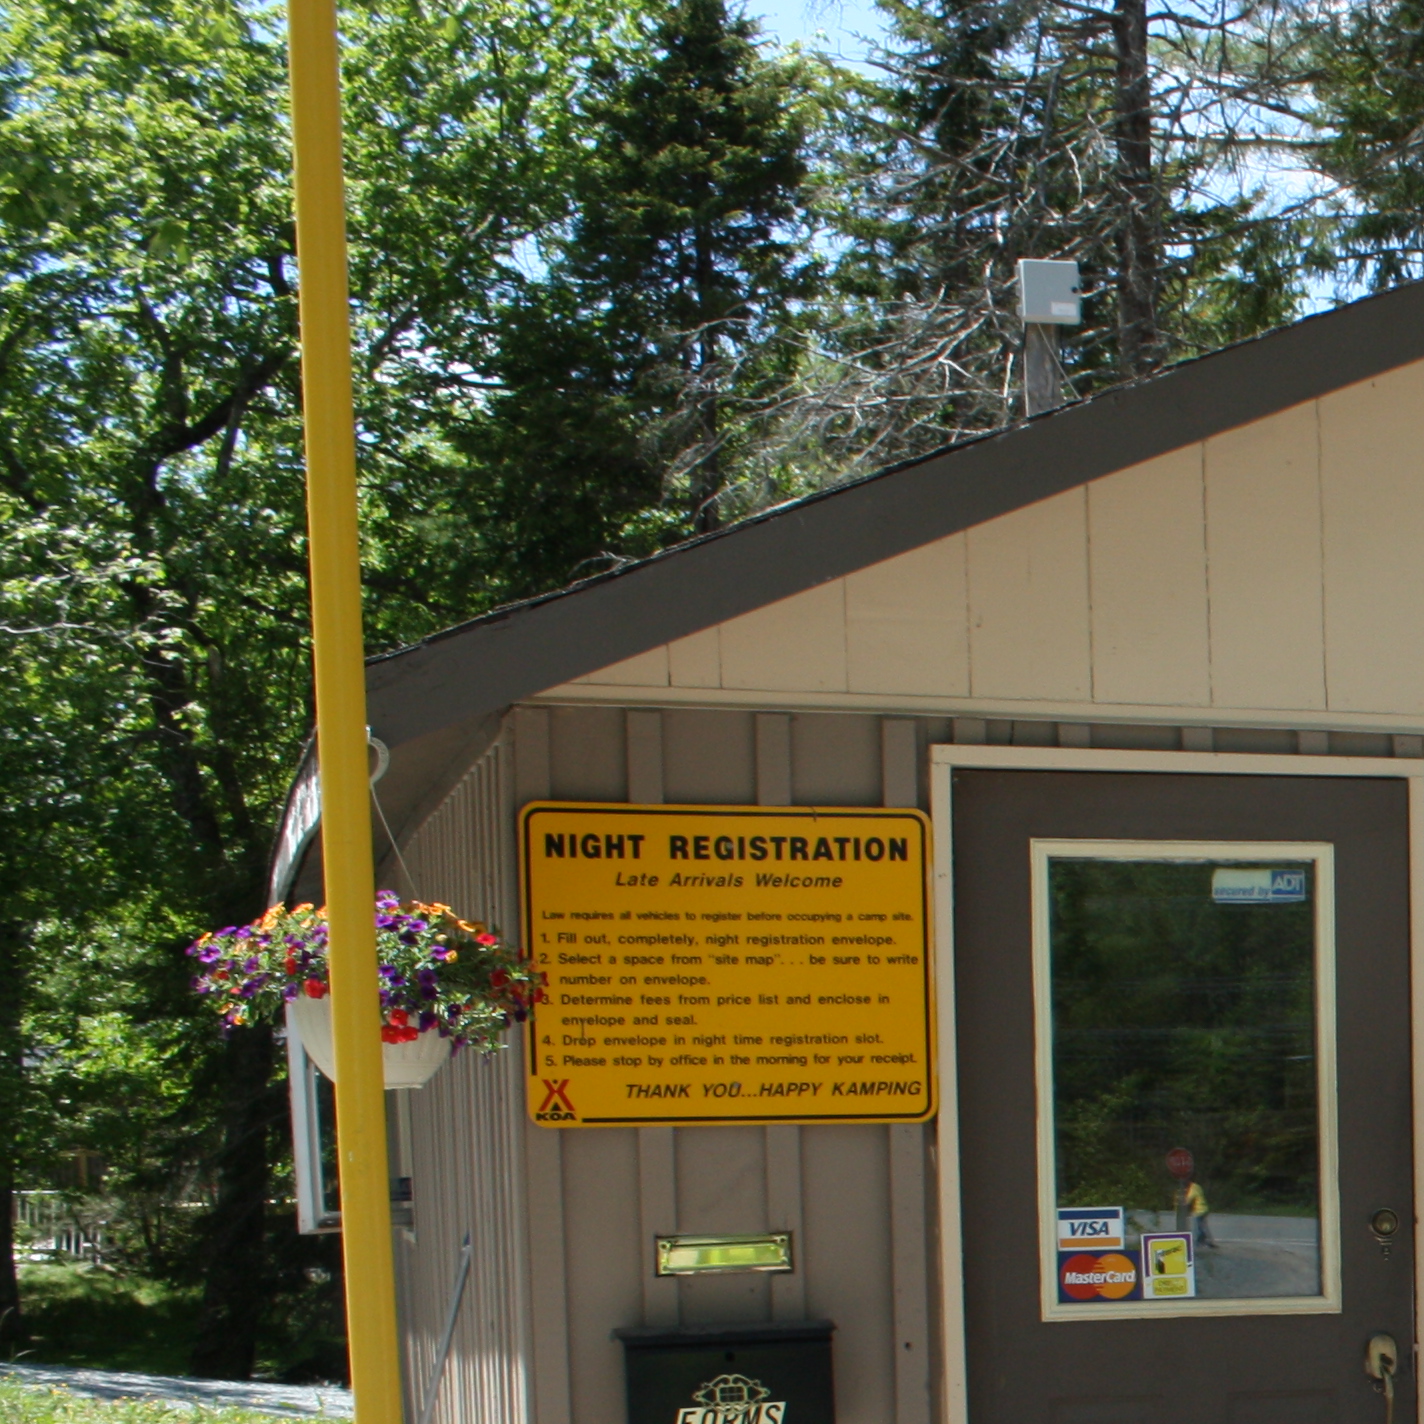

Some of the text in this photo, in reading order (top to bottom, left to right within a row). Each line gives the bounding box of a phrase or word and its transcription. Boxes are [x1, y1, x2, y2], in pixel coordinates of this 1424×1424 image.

[545, 834, 908, 861] NIGHT REGISTRATION
[615, 872, 843, 888] Late Arrivals Welcome
[1272, 874, 1303, 890] ADT
[542, 911, 565, 920] Law
[570, 911, 614, 922] requires
[619, 911, 631, 920] all
[636, 911, 680, 920] vehicles
[686, 911, 696, 920] to
[701, 911, 741, 922] register
[747, 912, 782, 921] before
[787, 912, 842, 922] occupying
[858, 914, 887, 922] camp
[892, 912, 914, 921] site.
[540, 932, 897, 946] 1. Fill out, completely, night registration envelope.
[539, 953, 551, 964] 2.
[558, 952, 601, 965] Select
[609, 956, 616, 965] a
[624, 955, 664, 966] space
[672, 954, 702, 965] from
[809, 954, 826, 965] be
[833, 956, 860, 965] sure
[867, 954, 880, 965] to
[887, 954, 918, 965] write
[560, 974, 711, 987] number on envelope.
[541, 993, 890, 1007] 3. Determine fees from price list and enclose in
[561, 1015, 698, 1027] envelope and seal.
[542, 1033, 884, 1047] 4. Drop envelope in night time registration slot.
[545, 1053, 917, 1068] 5. Please stop by office in the morning for your receipt.
[625, 1083, 691, 1099] THANK
[831, 1081, 921, 1097] KAMPING
[536, 1112, 577, 1122] KOA
[1069, 1221, 1110, 1236] VISA
[1064, 1270, 1136, 1285] MasterCard
